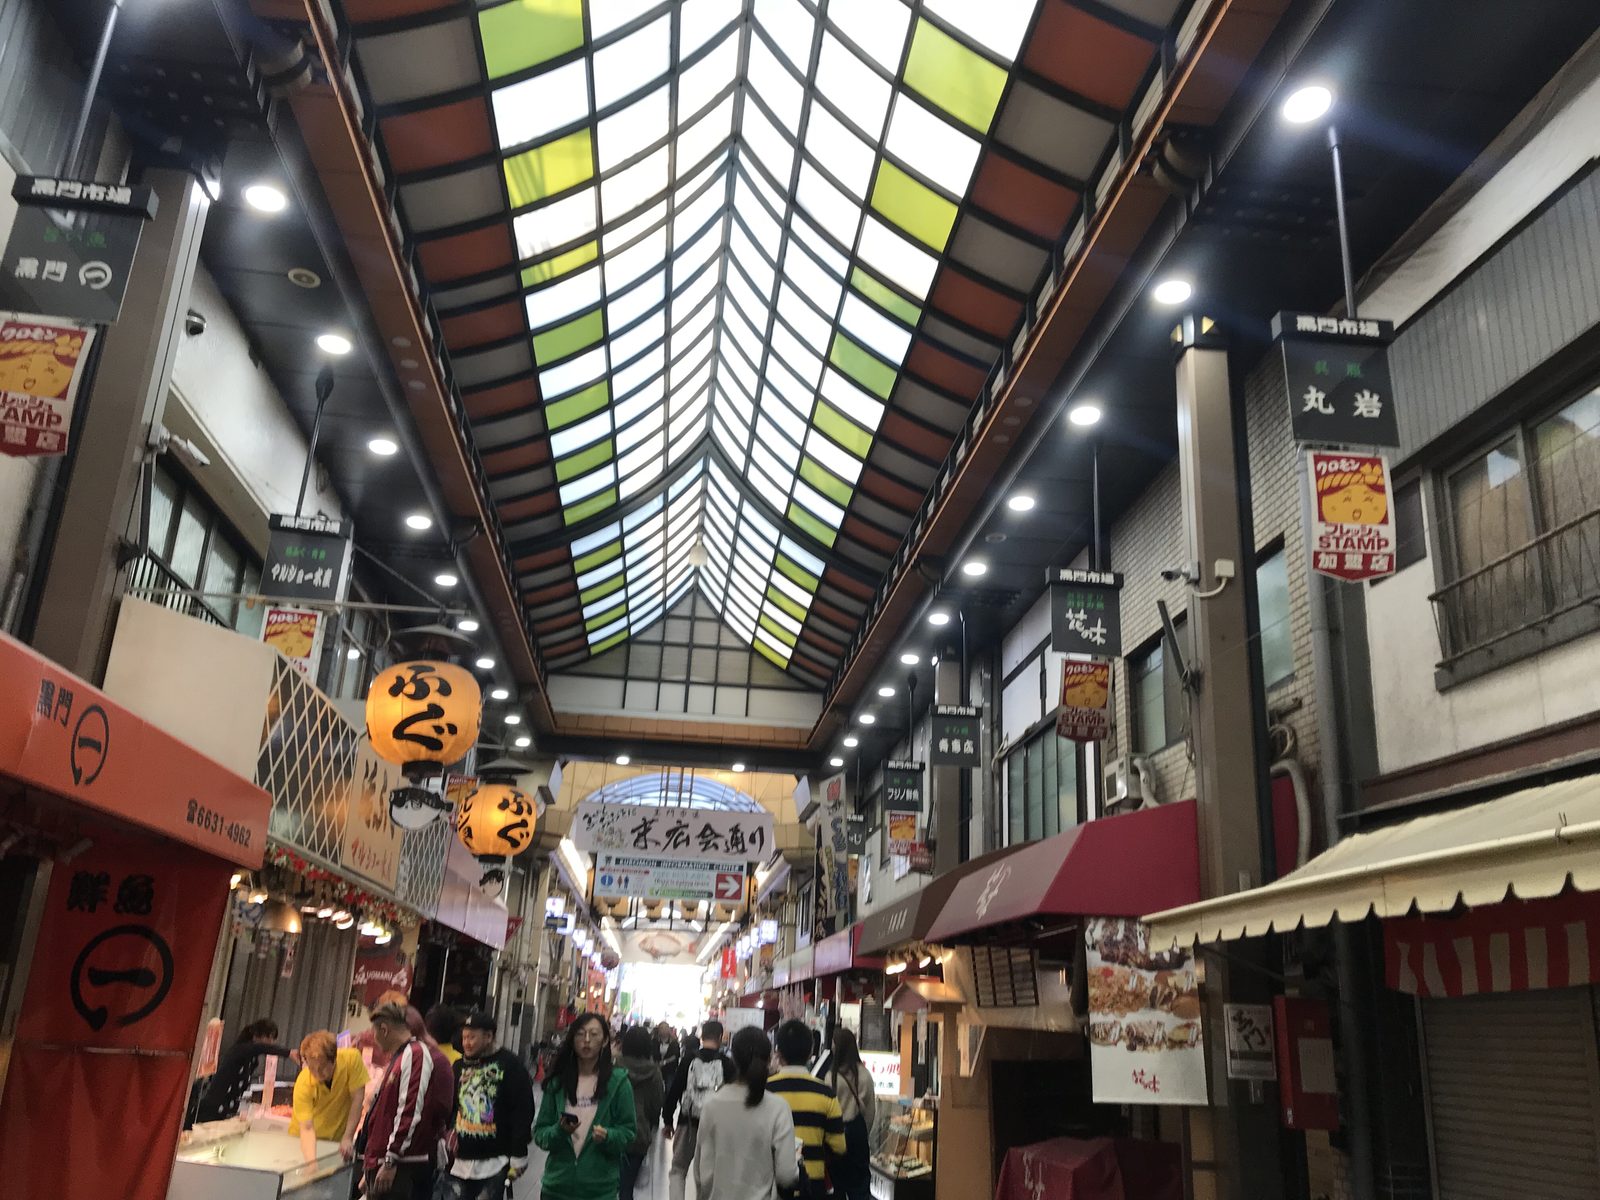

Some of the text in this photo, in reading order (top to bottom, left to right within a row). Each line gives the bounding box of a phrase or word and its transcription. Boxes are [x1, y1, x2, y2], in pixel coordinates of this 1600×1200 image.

[1296, 315, 1380, 337] 黒門市場
[1302, 385, 1383, 418] 丸岩
[1316, 458, 1360, 476] クロモン
[1318, 535, 1390, 551] STAMP
[1318, 552, 1389, 571] 加盟店
[388, 664, 458, 751] ふぐ
[1060, 713, 1106, 725] STAMP
[497, 789, 533, 848] ふぐ
